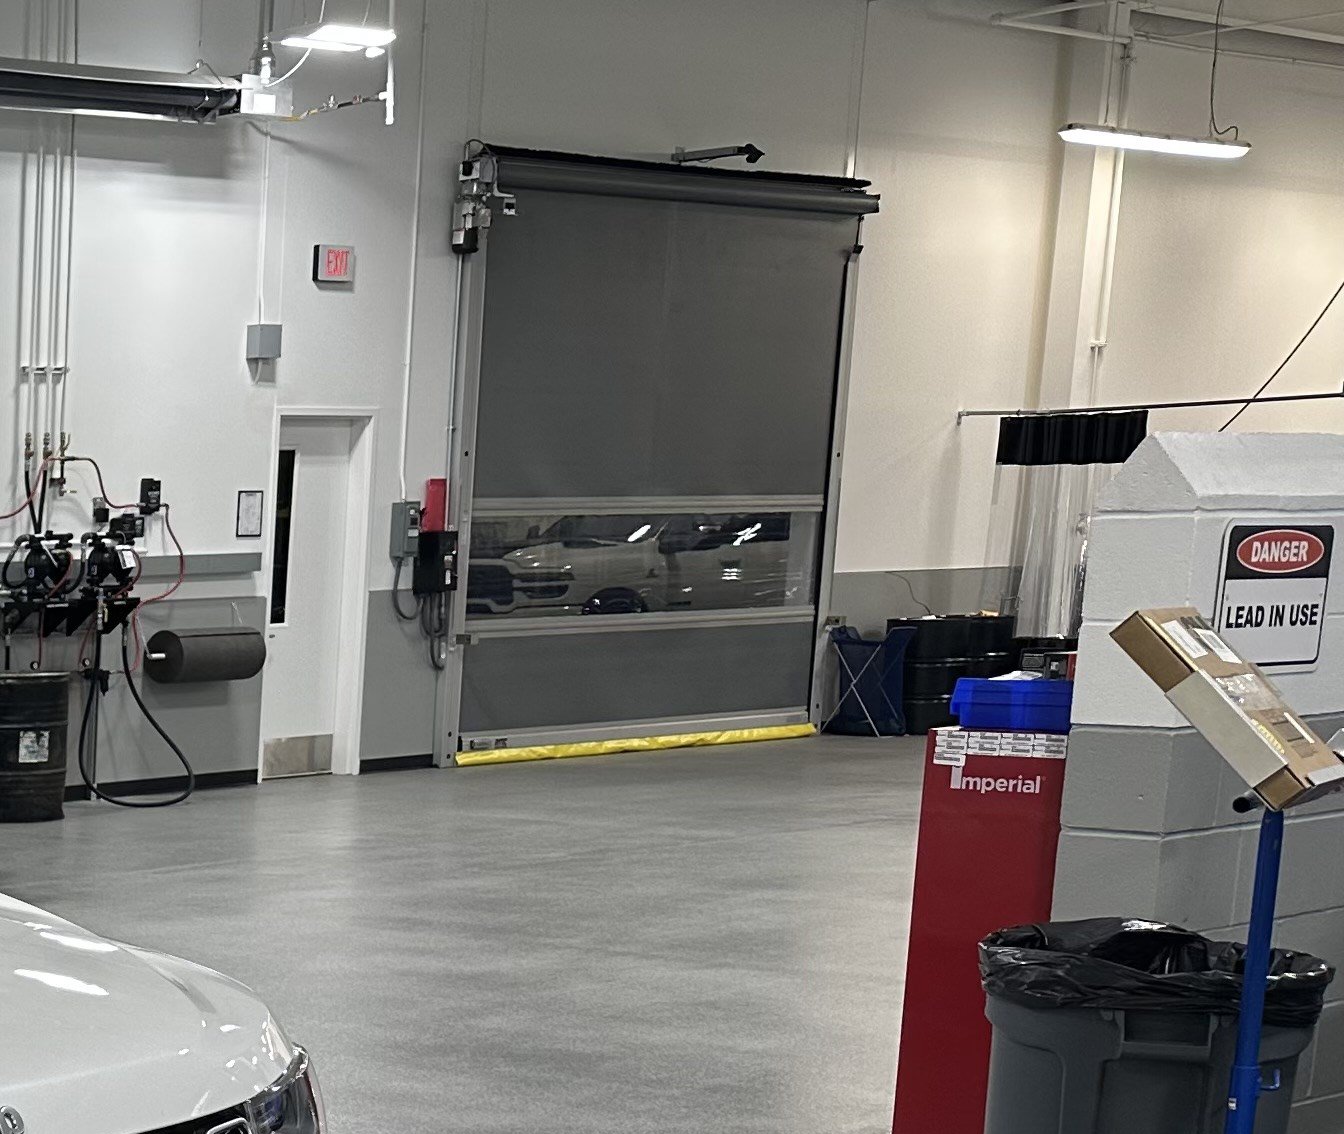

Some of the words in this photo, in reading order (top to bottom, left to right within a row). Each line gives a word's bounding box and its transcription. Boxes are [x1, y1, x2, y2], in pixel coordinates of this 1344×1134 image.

[326, 249, 350, 276] EXIT
[1251, 540, 1309, 562] DANGER
[1225, 605, 1265, 629] LEAD
[1268, 604, 1286, 628] IN
[1289, 603, 1320, 627] USE
[949, 765, 1041, 794] Imperial
